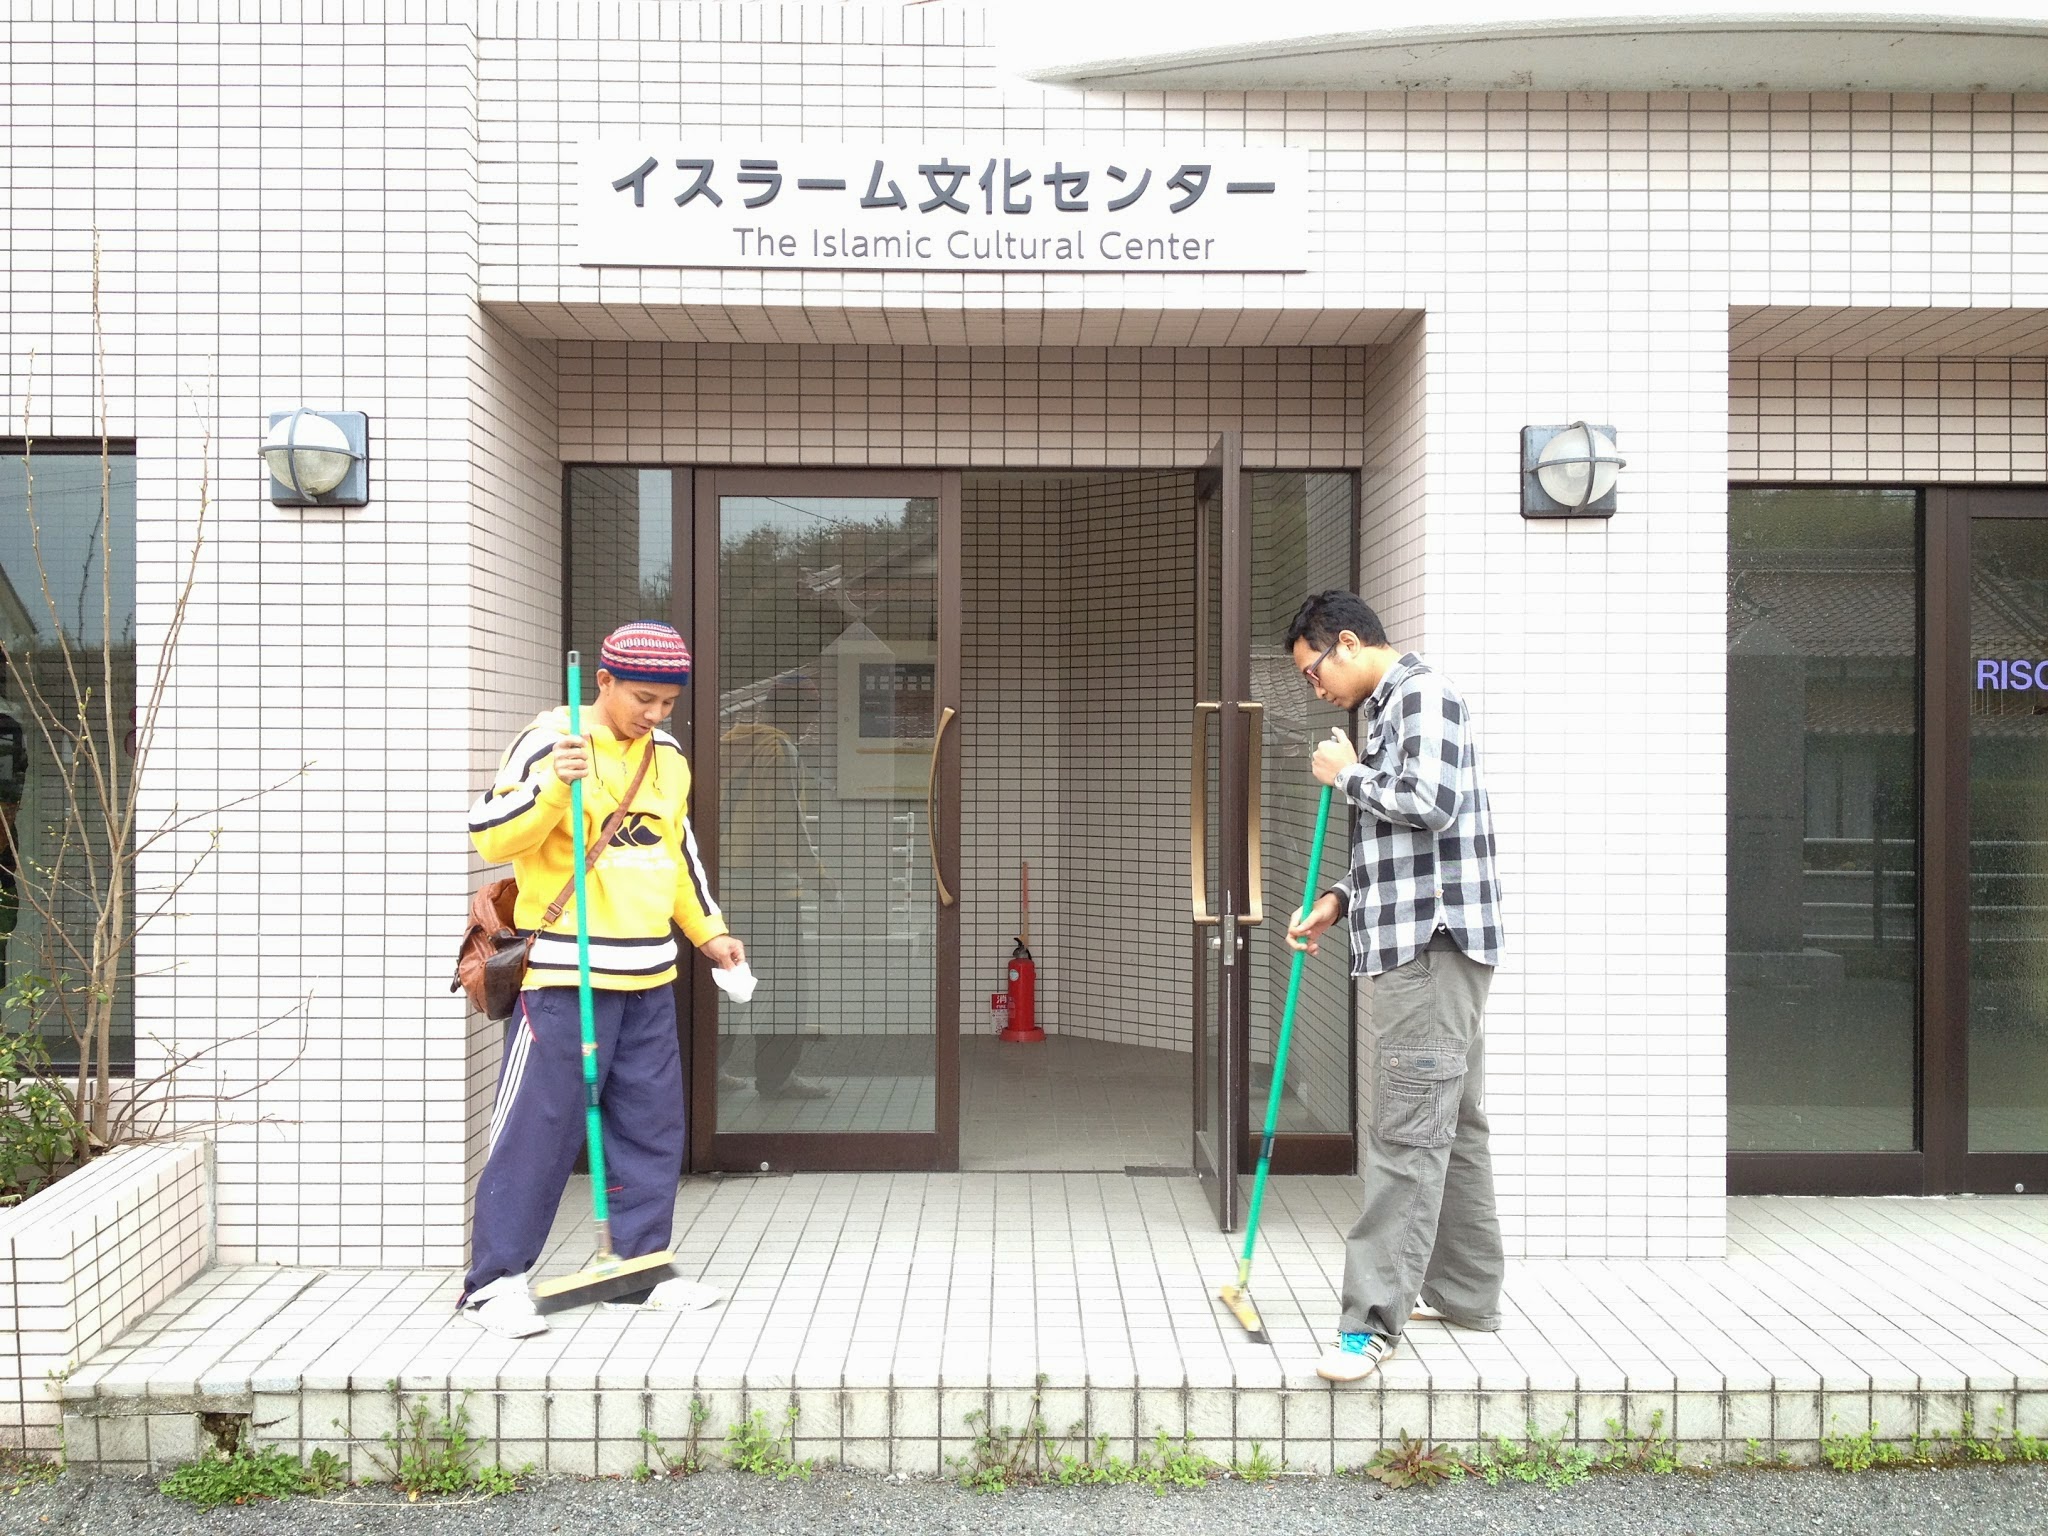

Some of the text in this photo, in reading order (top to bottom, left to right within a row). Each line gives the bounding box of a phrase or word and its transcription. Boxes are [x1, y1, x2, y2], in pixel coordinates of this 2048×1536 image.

[611, 156, 1276, 216] イスラーム文化センター
[733, 227, 1214, 260] The Islamic Cultural Center
